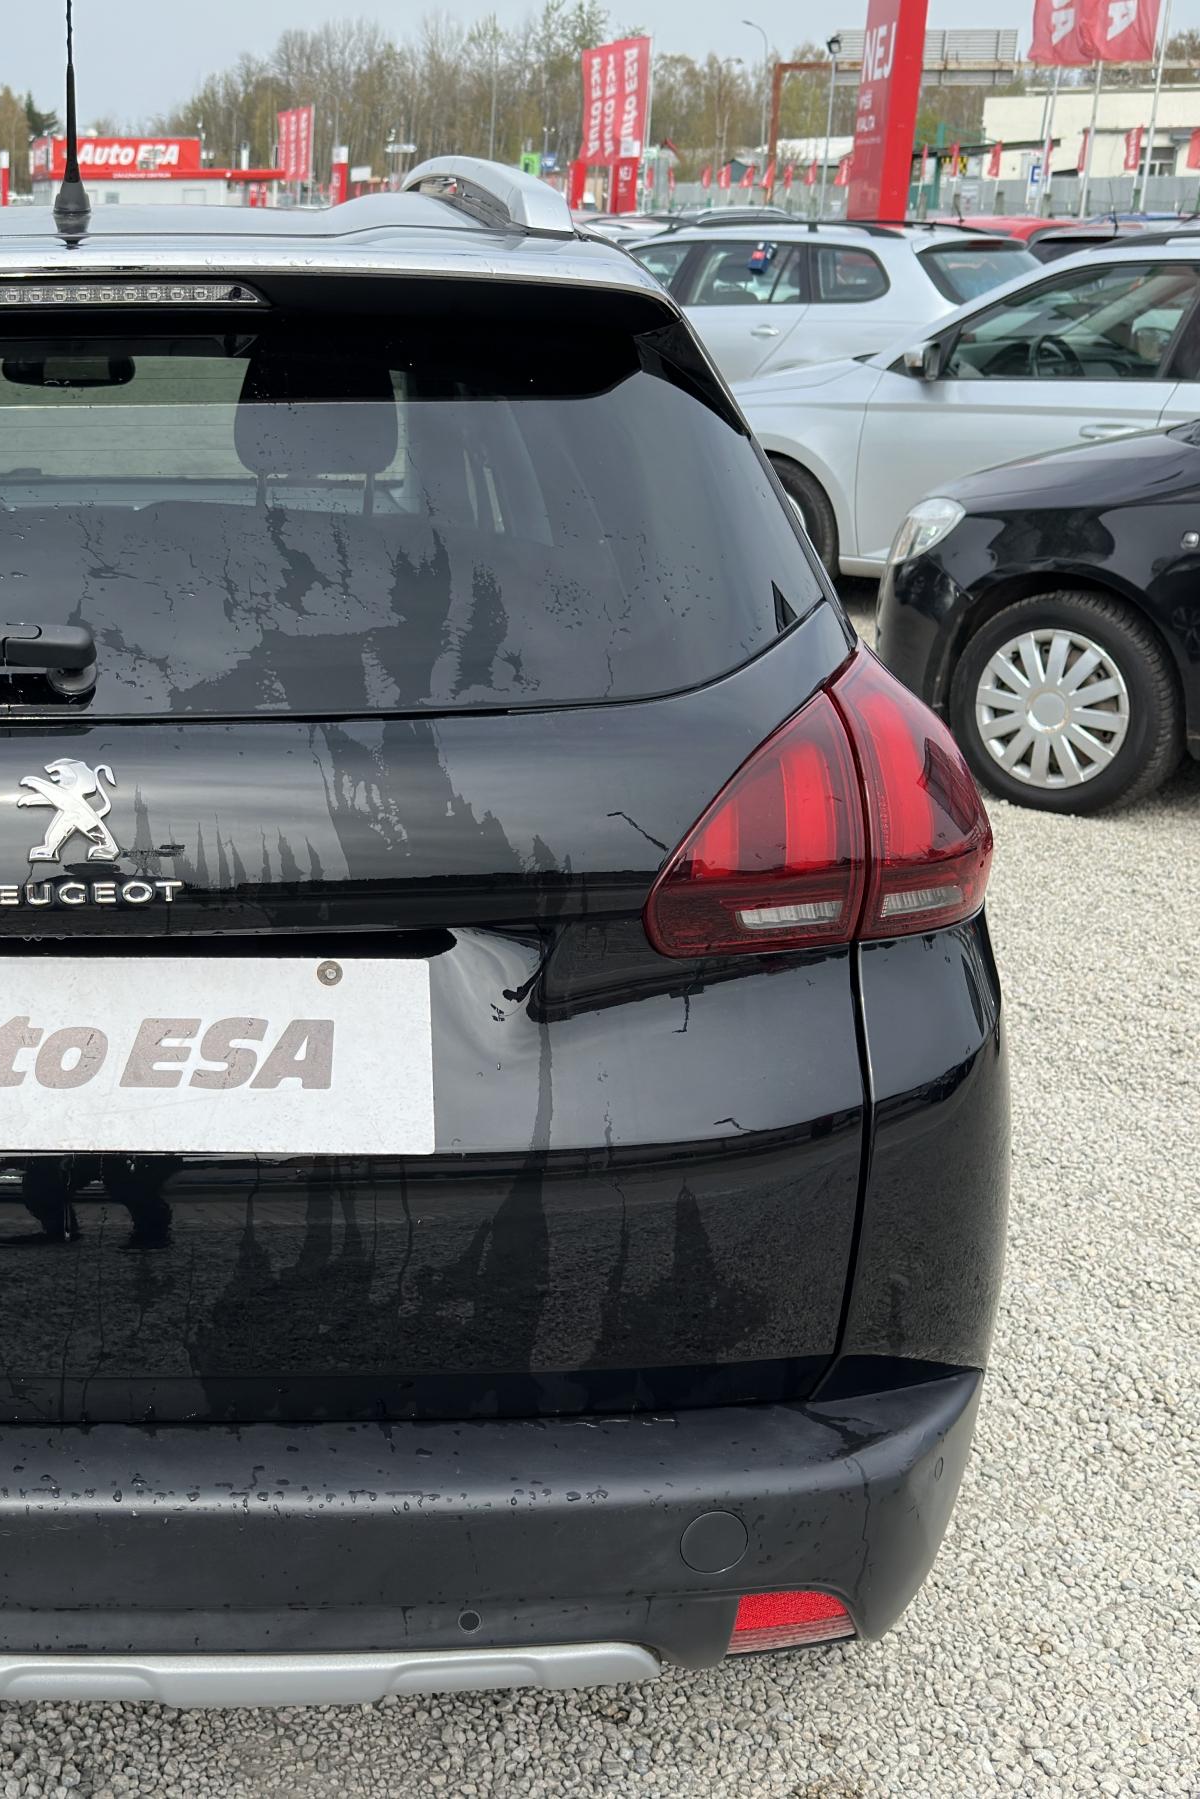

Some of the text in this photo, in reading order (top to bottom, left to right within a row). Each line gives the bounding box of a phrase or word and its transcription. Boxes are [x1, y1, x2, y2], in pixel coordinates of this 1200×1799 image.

[862, 21, 897, 83] NEJ
[78, 143, 135, 166] Auto
[118, 1016, 335, 1090] ESA
